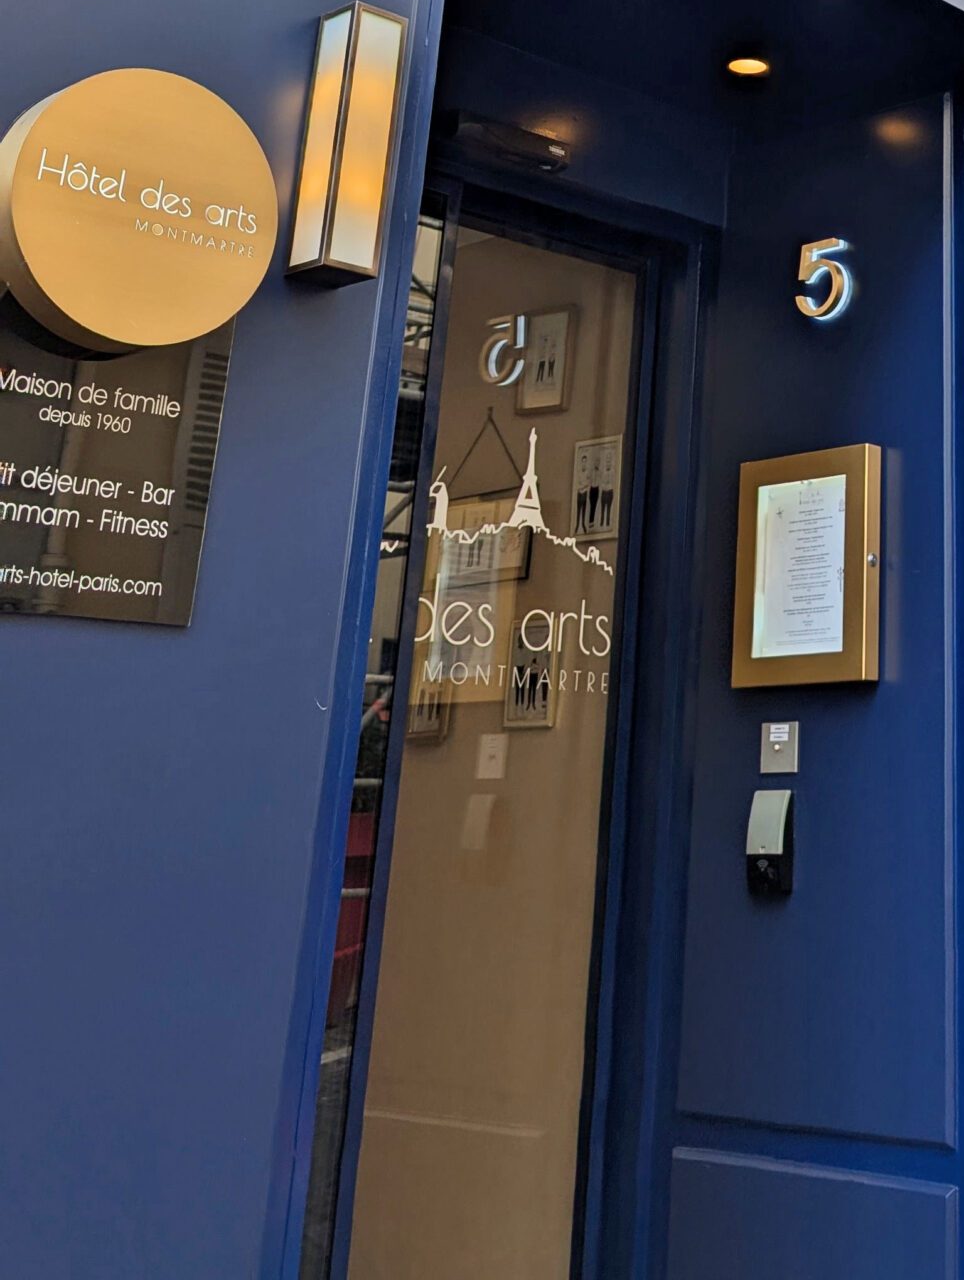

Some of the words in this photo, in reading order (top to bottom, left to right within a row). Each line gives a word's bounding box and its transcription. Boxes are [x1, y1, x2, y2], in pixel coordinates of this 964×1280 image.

[37, 148, 126, 203] Hôtel
[140, 179, 192, 218] des
[204, 205, 257, 235] arts
[135, 218, 254, 258] MONTMARTRE
[795, 237, 852, 320] 5
[0, 368, 72, 400] Maison
[78, 382, 108, 406] de
[113, 387, 181, 418] famille
[39, 405, 91, 428] depuis
[96, 412, 132, 434] 1960
[20, 465, 123, 499] déjeuner
[141, 481, 176, 506] Bar
[99, 508, 169, 538] Fitness
[414, 572, 495, 647] des
[521, 598, 611, 657] arts
[422, 660, 609, 695] MONTMARTRE
